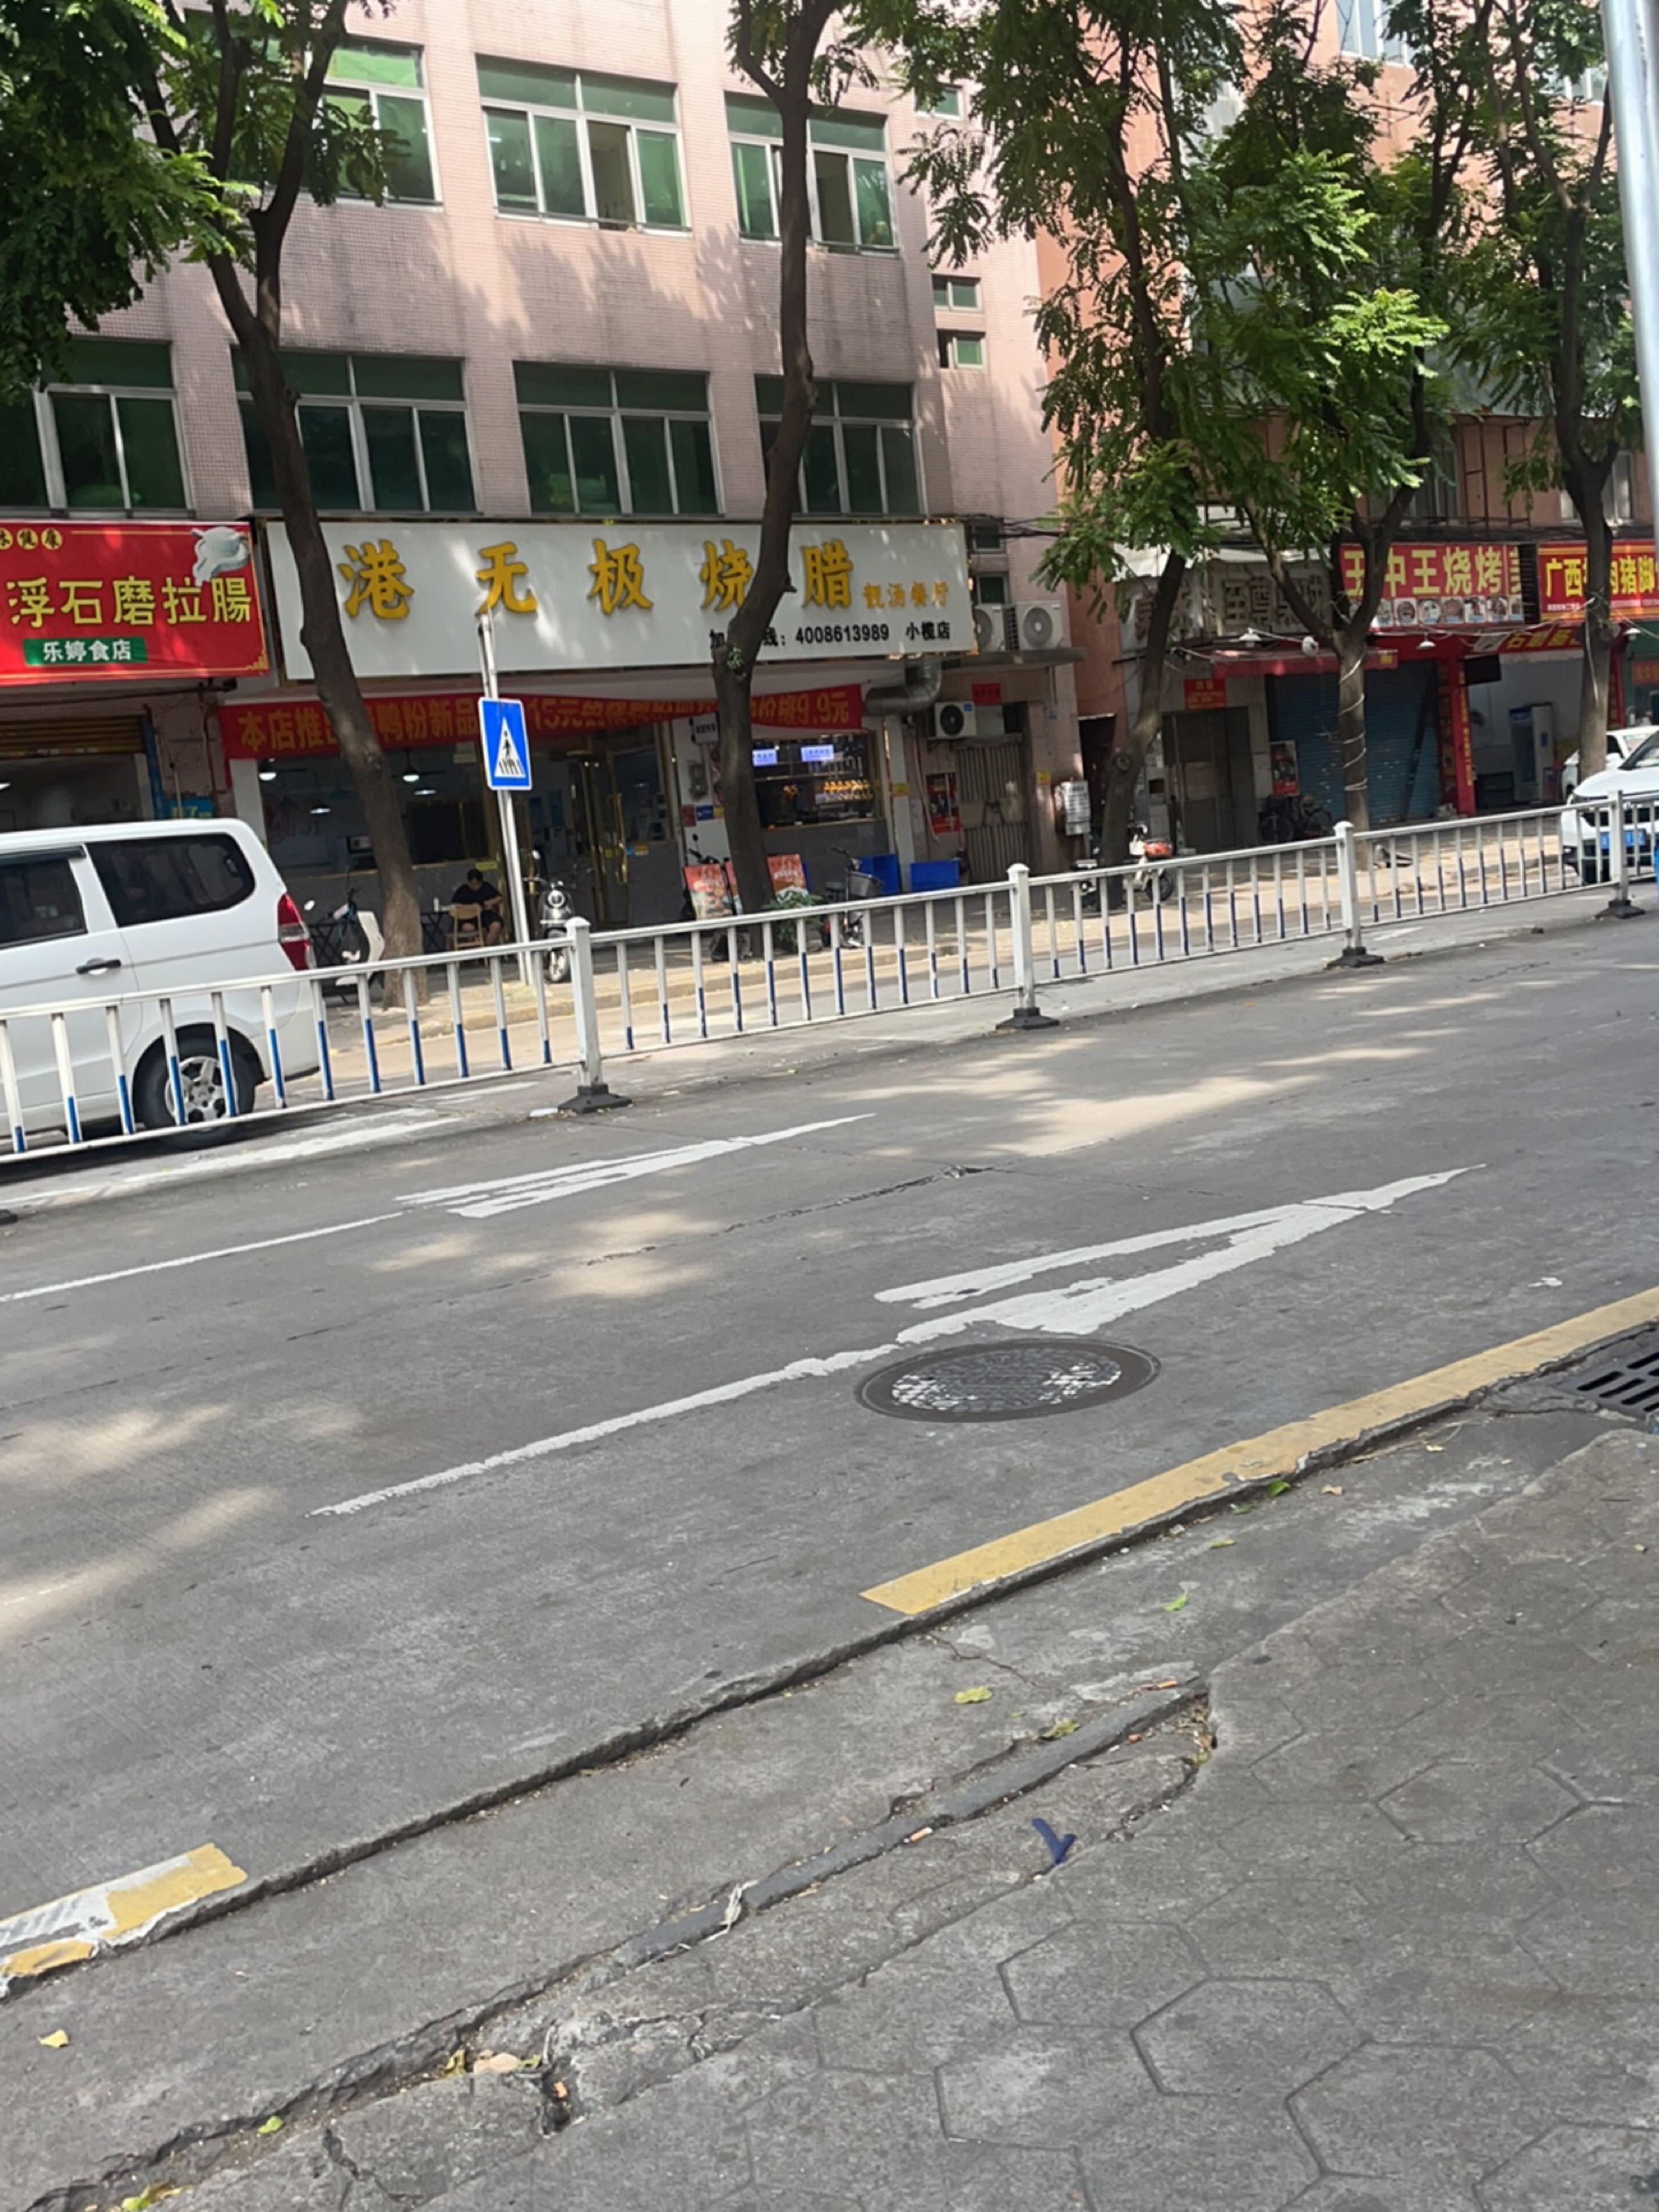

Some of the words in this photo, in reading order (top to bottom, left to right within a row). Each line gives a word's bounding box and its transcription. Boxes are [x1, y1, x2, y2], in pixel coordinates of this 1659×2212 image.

[43, 639, 132, 663] 乐婷食店
[239, 697, 478, 752] 本店推鸭粉新品
